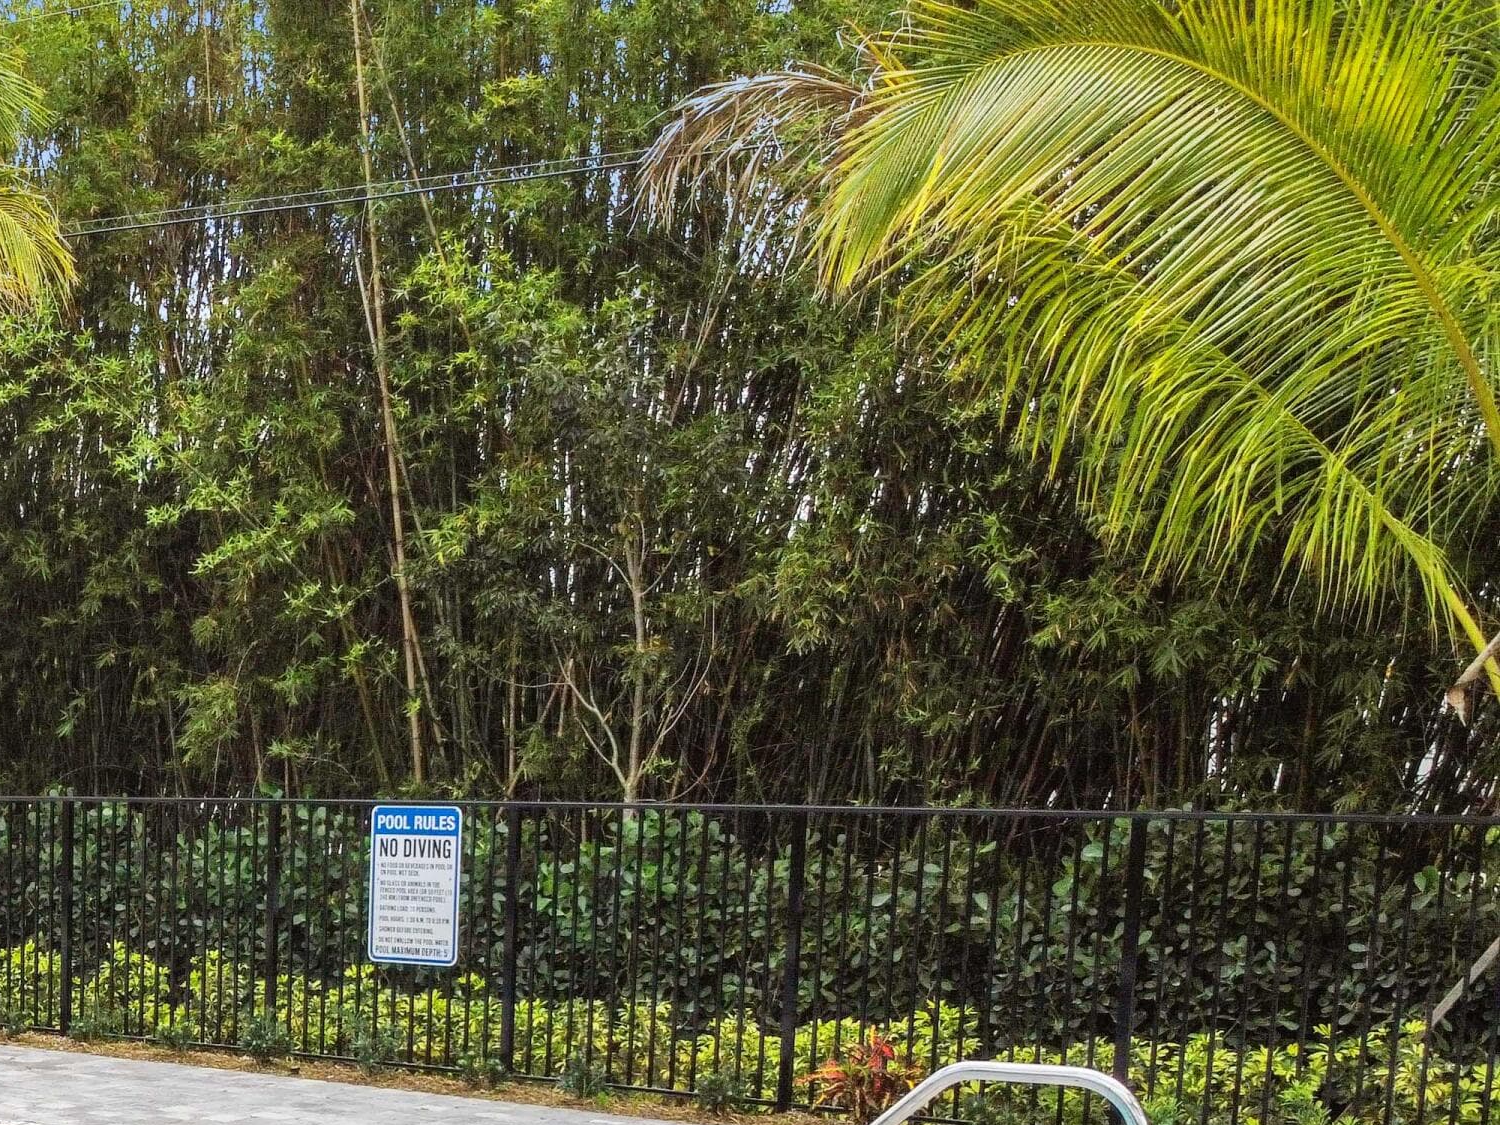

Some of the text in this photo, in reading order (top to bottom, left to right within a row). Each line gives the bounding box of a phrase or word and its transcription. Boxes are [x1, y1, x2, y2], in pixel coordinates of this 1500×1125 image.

[377, 815, 456, 831] POOL RULES
[380, 838, 451, 859] NO DIVING
[375, 945, 389, 954] POOL
[391, 946, 420, 955] MAXIMUM
